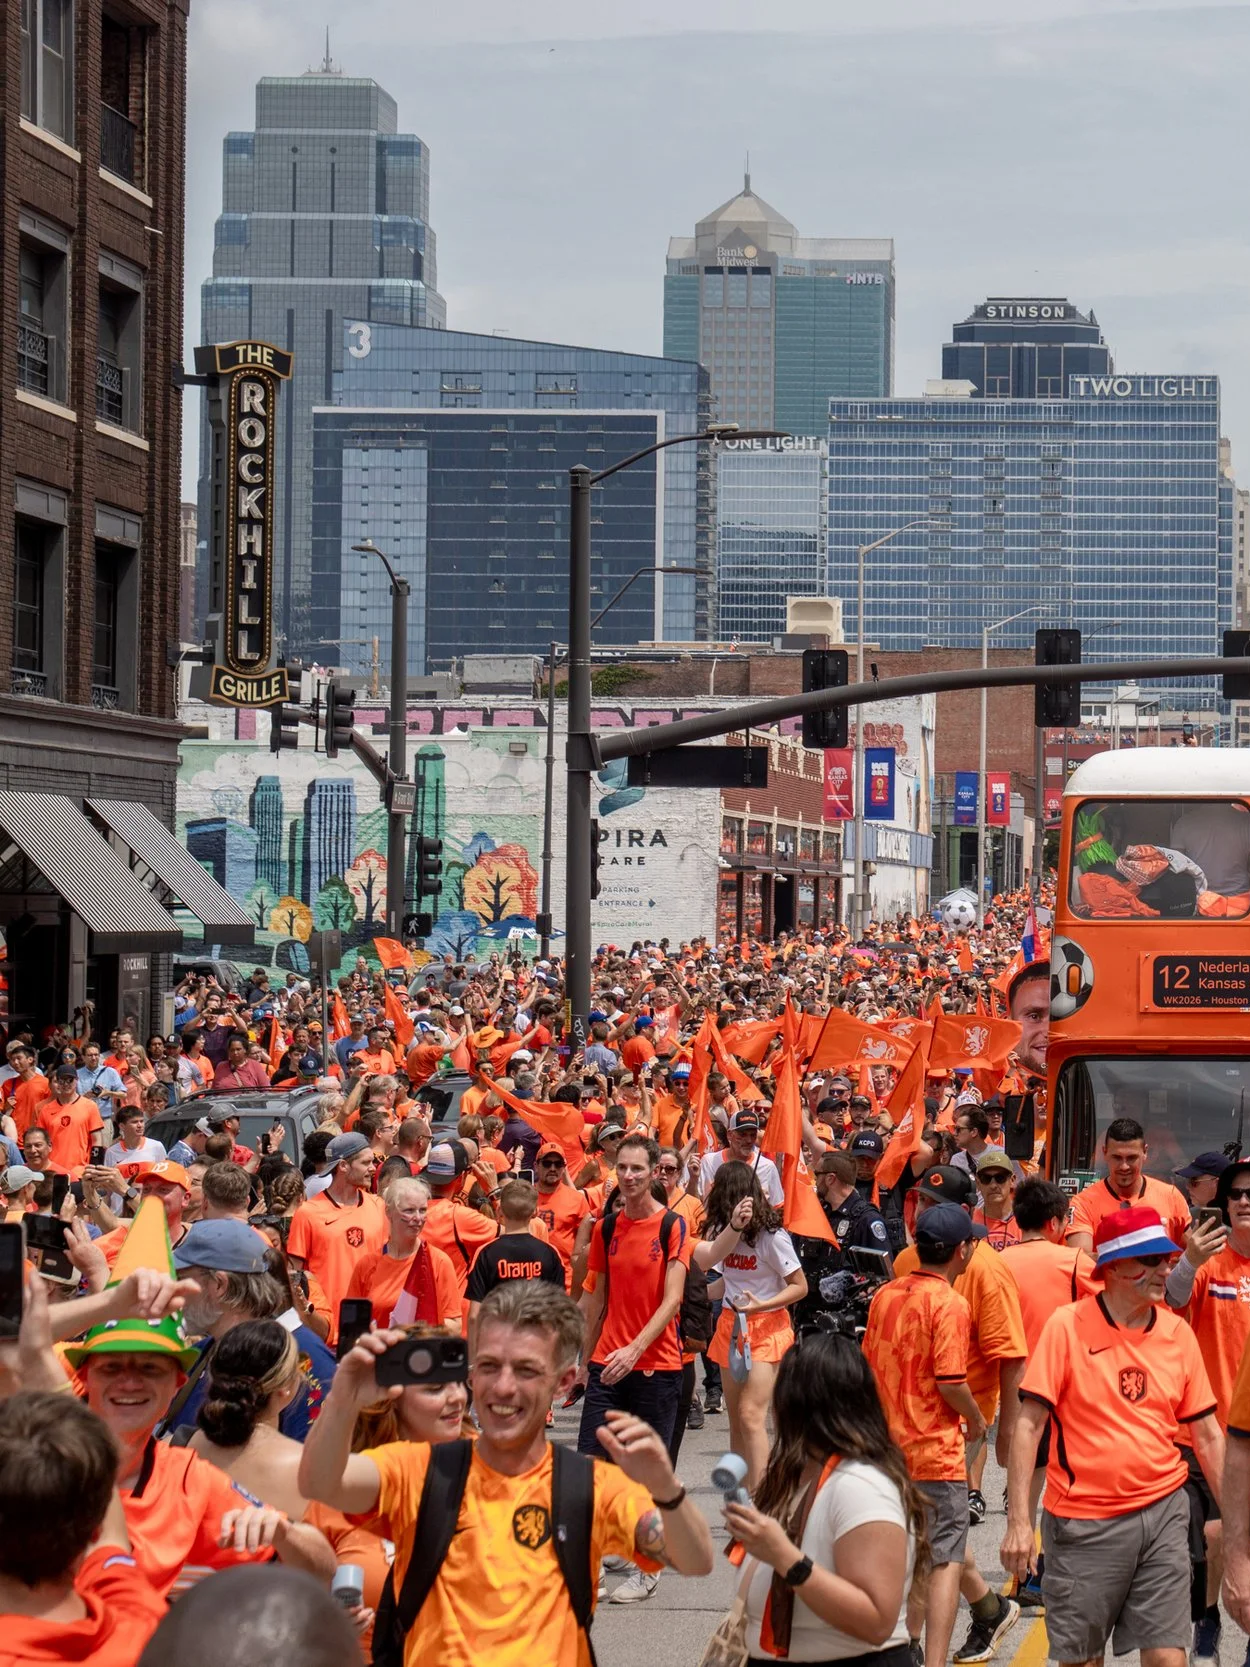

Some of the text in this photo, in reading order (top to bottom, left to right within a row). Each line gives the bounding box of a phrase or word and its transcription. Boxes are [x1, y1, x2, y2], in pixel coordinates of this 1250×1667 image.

[717, 247, 743, 257] Bank
[717, 256, 759, 267] Midwest
[846, 273, 884, 285] HNTB
[986, 306, 1065, 318] STINSON
[349, 322, 372, 359] 3
[235, 345, 274, 367] THE
[1075, 378, 1211, 397] TWO LIGHT
[726, 436, 817, 450] ONE LIGHT
[237, 382, 267, 661] ROCKHILL
[219, 675, 281, 702] GRILLE
[598, 829, 669, 848] PIRA
[1158, 964, 1191, 990] 12
[1198, 977, 1246, 989] Kansas
[1163, 996, 1201, 1005] WK2026
[1211, 996, 1249, 1005] Houston
[858, 1139, 876, 1148] KCPD
[497, 1258, 542, 1281] Oranje
